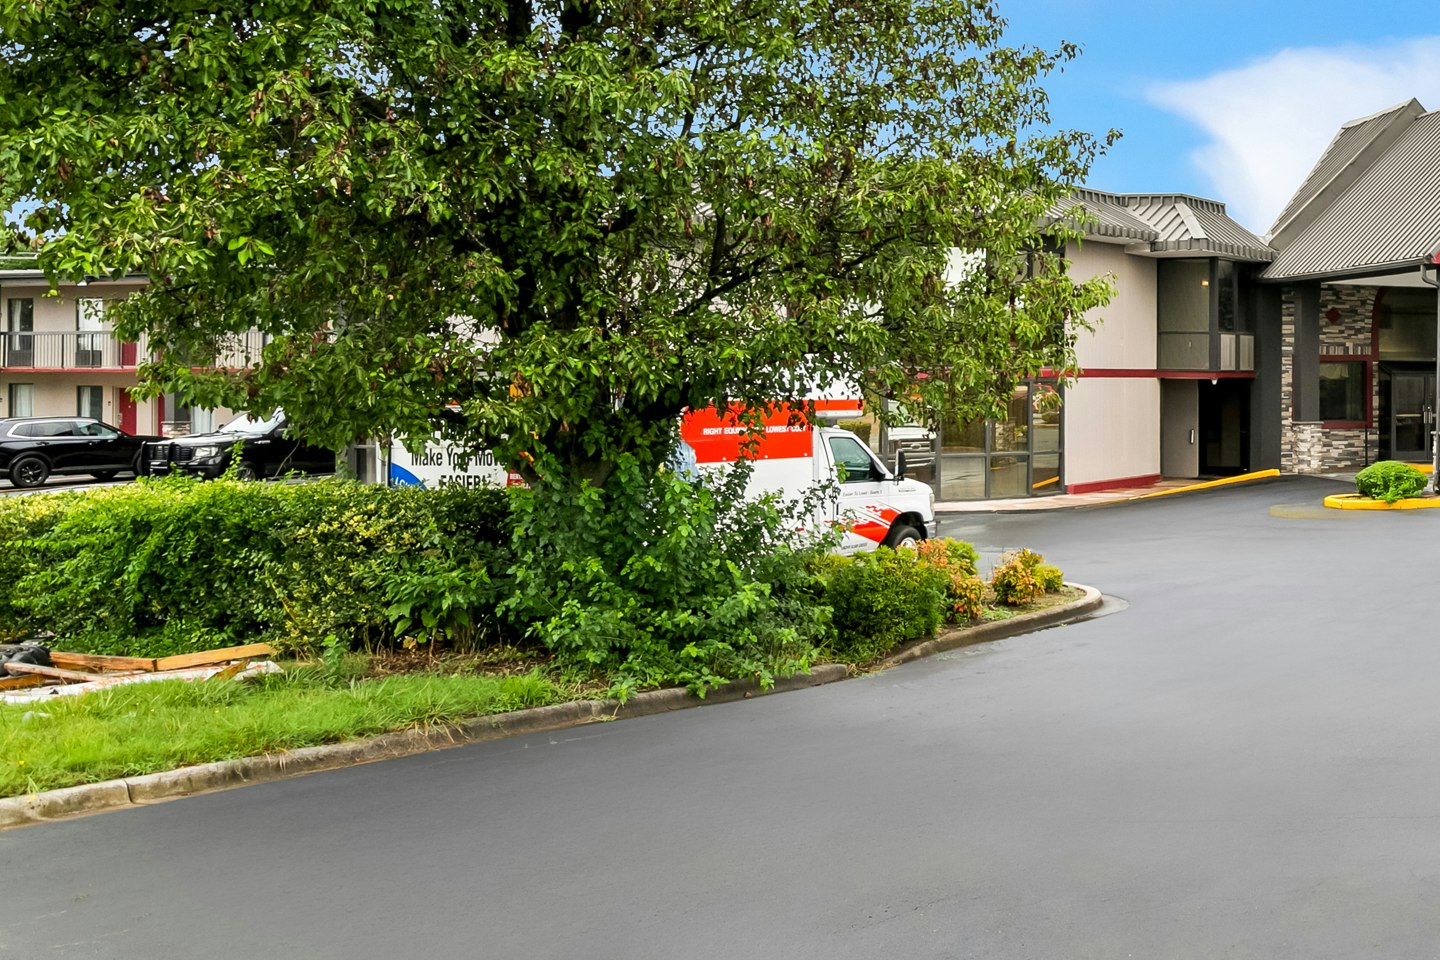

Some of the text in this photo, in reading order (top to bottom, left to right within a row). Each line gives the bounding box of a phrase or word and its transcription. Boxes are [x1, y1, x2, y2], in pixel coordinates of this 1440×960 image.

[703, 427, 722, 435] RIGHT
[411, 447, 443, 466] Make
[447, 447, 473, 466] Yor
